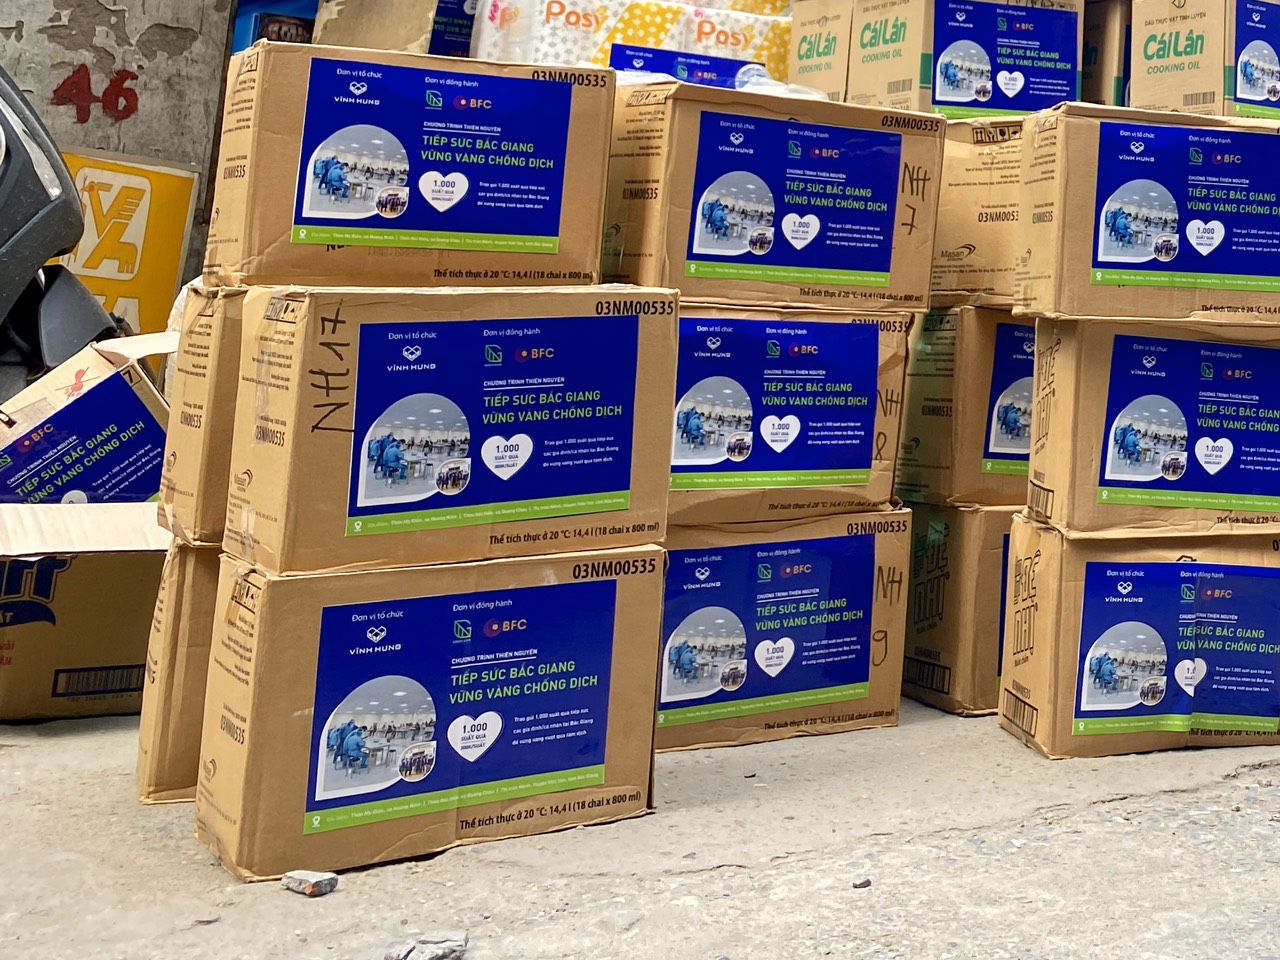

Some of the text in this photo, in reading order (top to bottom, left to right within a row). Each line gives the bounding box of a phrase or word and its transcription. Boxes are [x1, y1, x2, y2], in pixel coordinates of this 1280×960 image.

[52, 63, 139, 125] 46
[595, 300, 674, 316] 03NM00535
[531, 348, 554, 359] BFC
[484, 390, 601, 407] TIẾP SỨC BẮC GIANG
[482, 405, 622, 425] VỮNG VÀNG CHỐNG DỊCH
[496, 444, 520, 453] 1.000
[847, 520, 908, 535] 03NM00535
[572, 558, 656, 580] 03NM00535
[453, 599, 513, 612] Đơn vị đồng hành
[352, 610, 404, 622] Đơn vị tổ chức
[502, 619, 528, 632] BFC
[451, 661, 576, 687] TIẾP SỨC BẮC GIANG
[449, 675, 598, 705] VỮNG VÀNG CHỐNG DỊCH
[462, 721, 488, 733] 1.000
[460, 816, 476, 830] Thể
[478, 813, 494, 827] tích
[496, 813, 515, 825] thực
[517, 811, 521, 821] ở
[524, 809, 534, 818] 20
[549, 805, 567, 816] 14,4
[573, 800, 586, 812] (18
[588, 797, 604, 808] chai
[605, 798, 611, 806] x
[612, 795, 627, 805] 800
[628, 791, 641, 802] ml)
